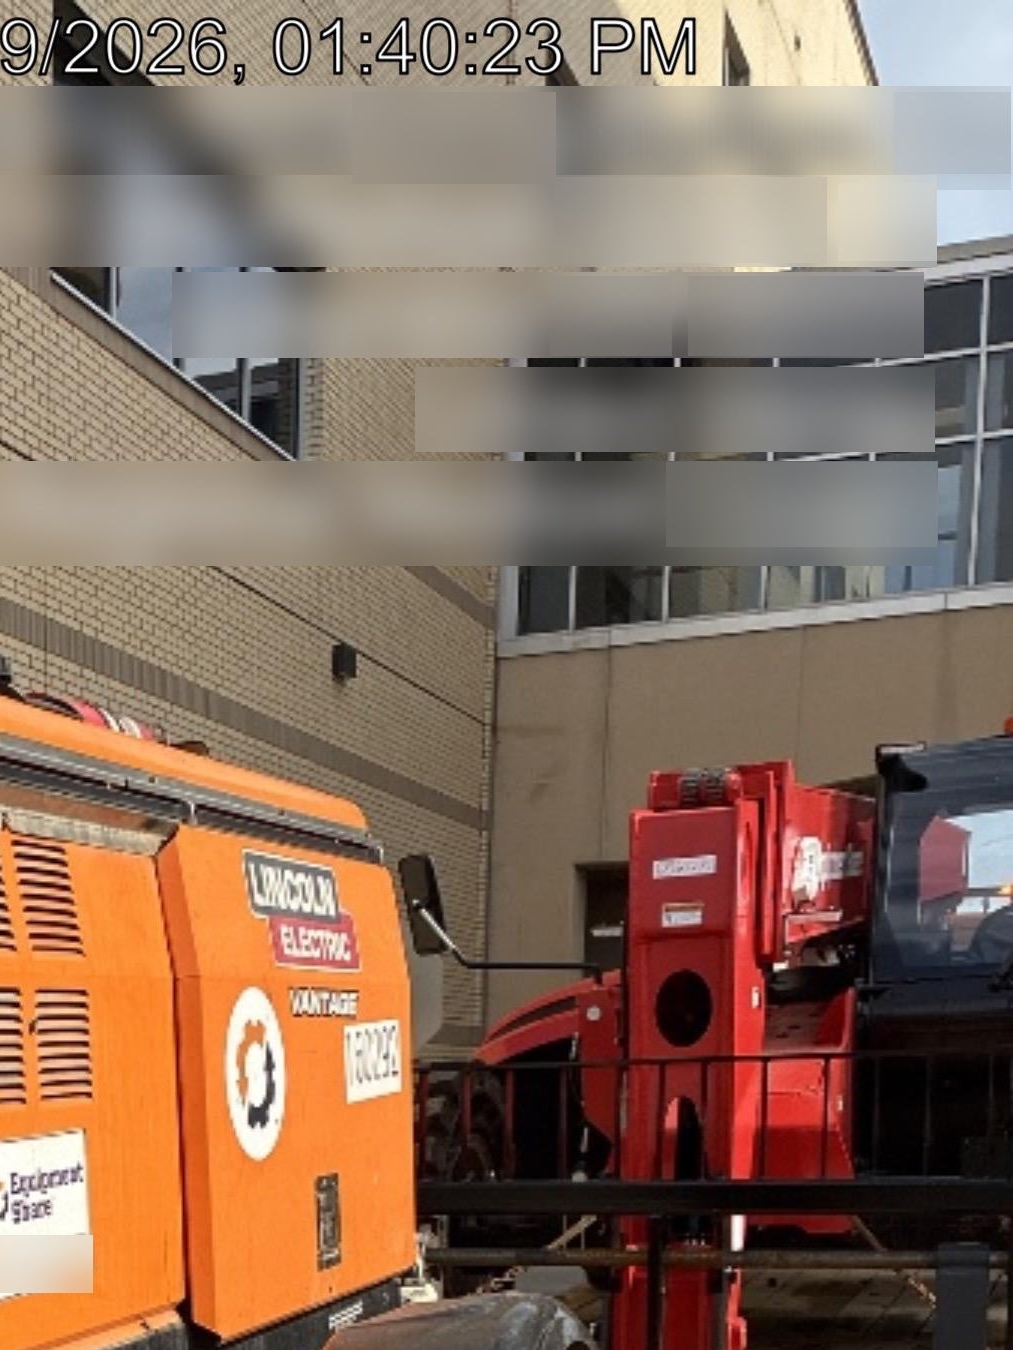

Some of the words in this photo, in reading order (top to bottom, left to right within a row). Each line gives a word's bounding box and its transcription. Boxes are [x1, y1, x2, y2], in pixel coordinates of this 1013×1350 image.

[248, 861, 336, 917] LINCOLN
[279, 924, 352, 961] ELECTRIC
[289, 986, 360, 1018] VANTAGE
[10, 1160, 85, 1198] Equipment
[11, 1198, 54, 1225] Share
